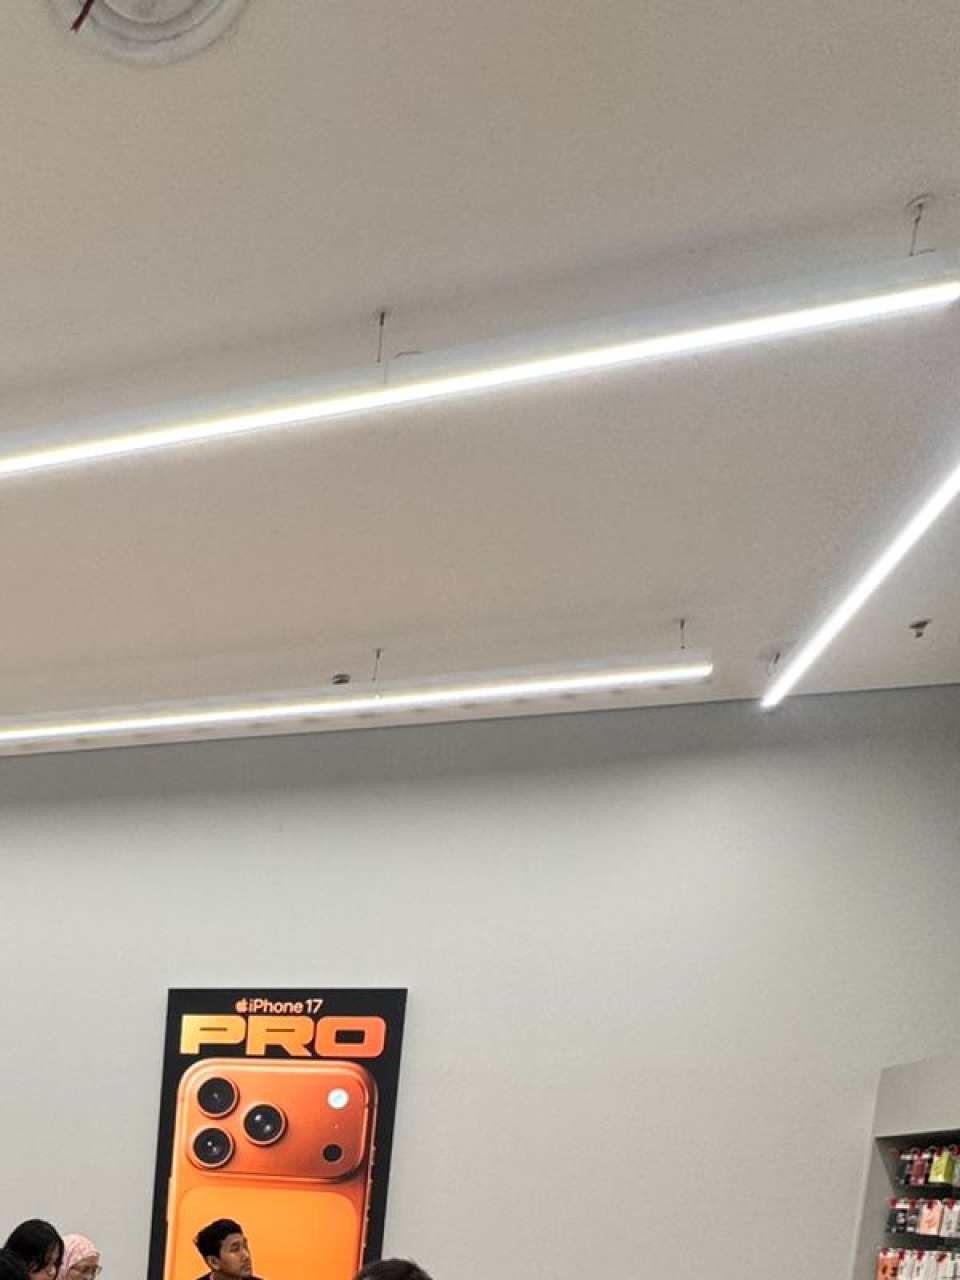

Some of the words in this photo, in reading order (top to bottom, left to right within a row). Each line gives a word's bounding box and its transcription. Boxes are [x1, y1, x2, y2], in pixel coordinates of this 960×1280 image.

[248, 998, 304, 1014] iPhone
[306, 998, 324, 1014] 17
[179, 1013, 387, 1059] PRO
